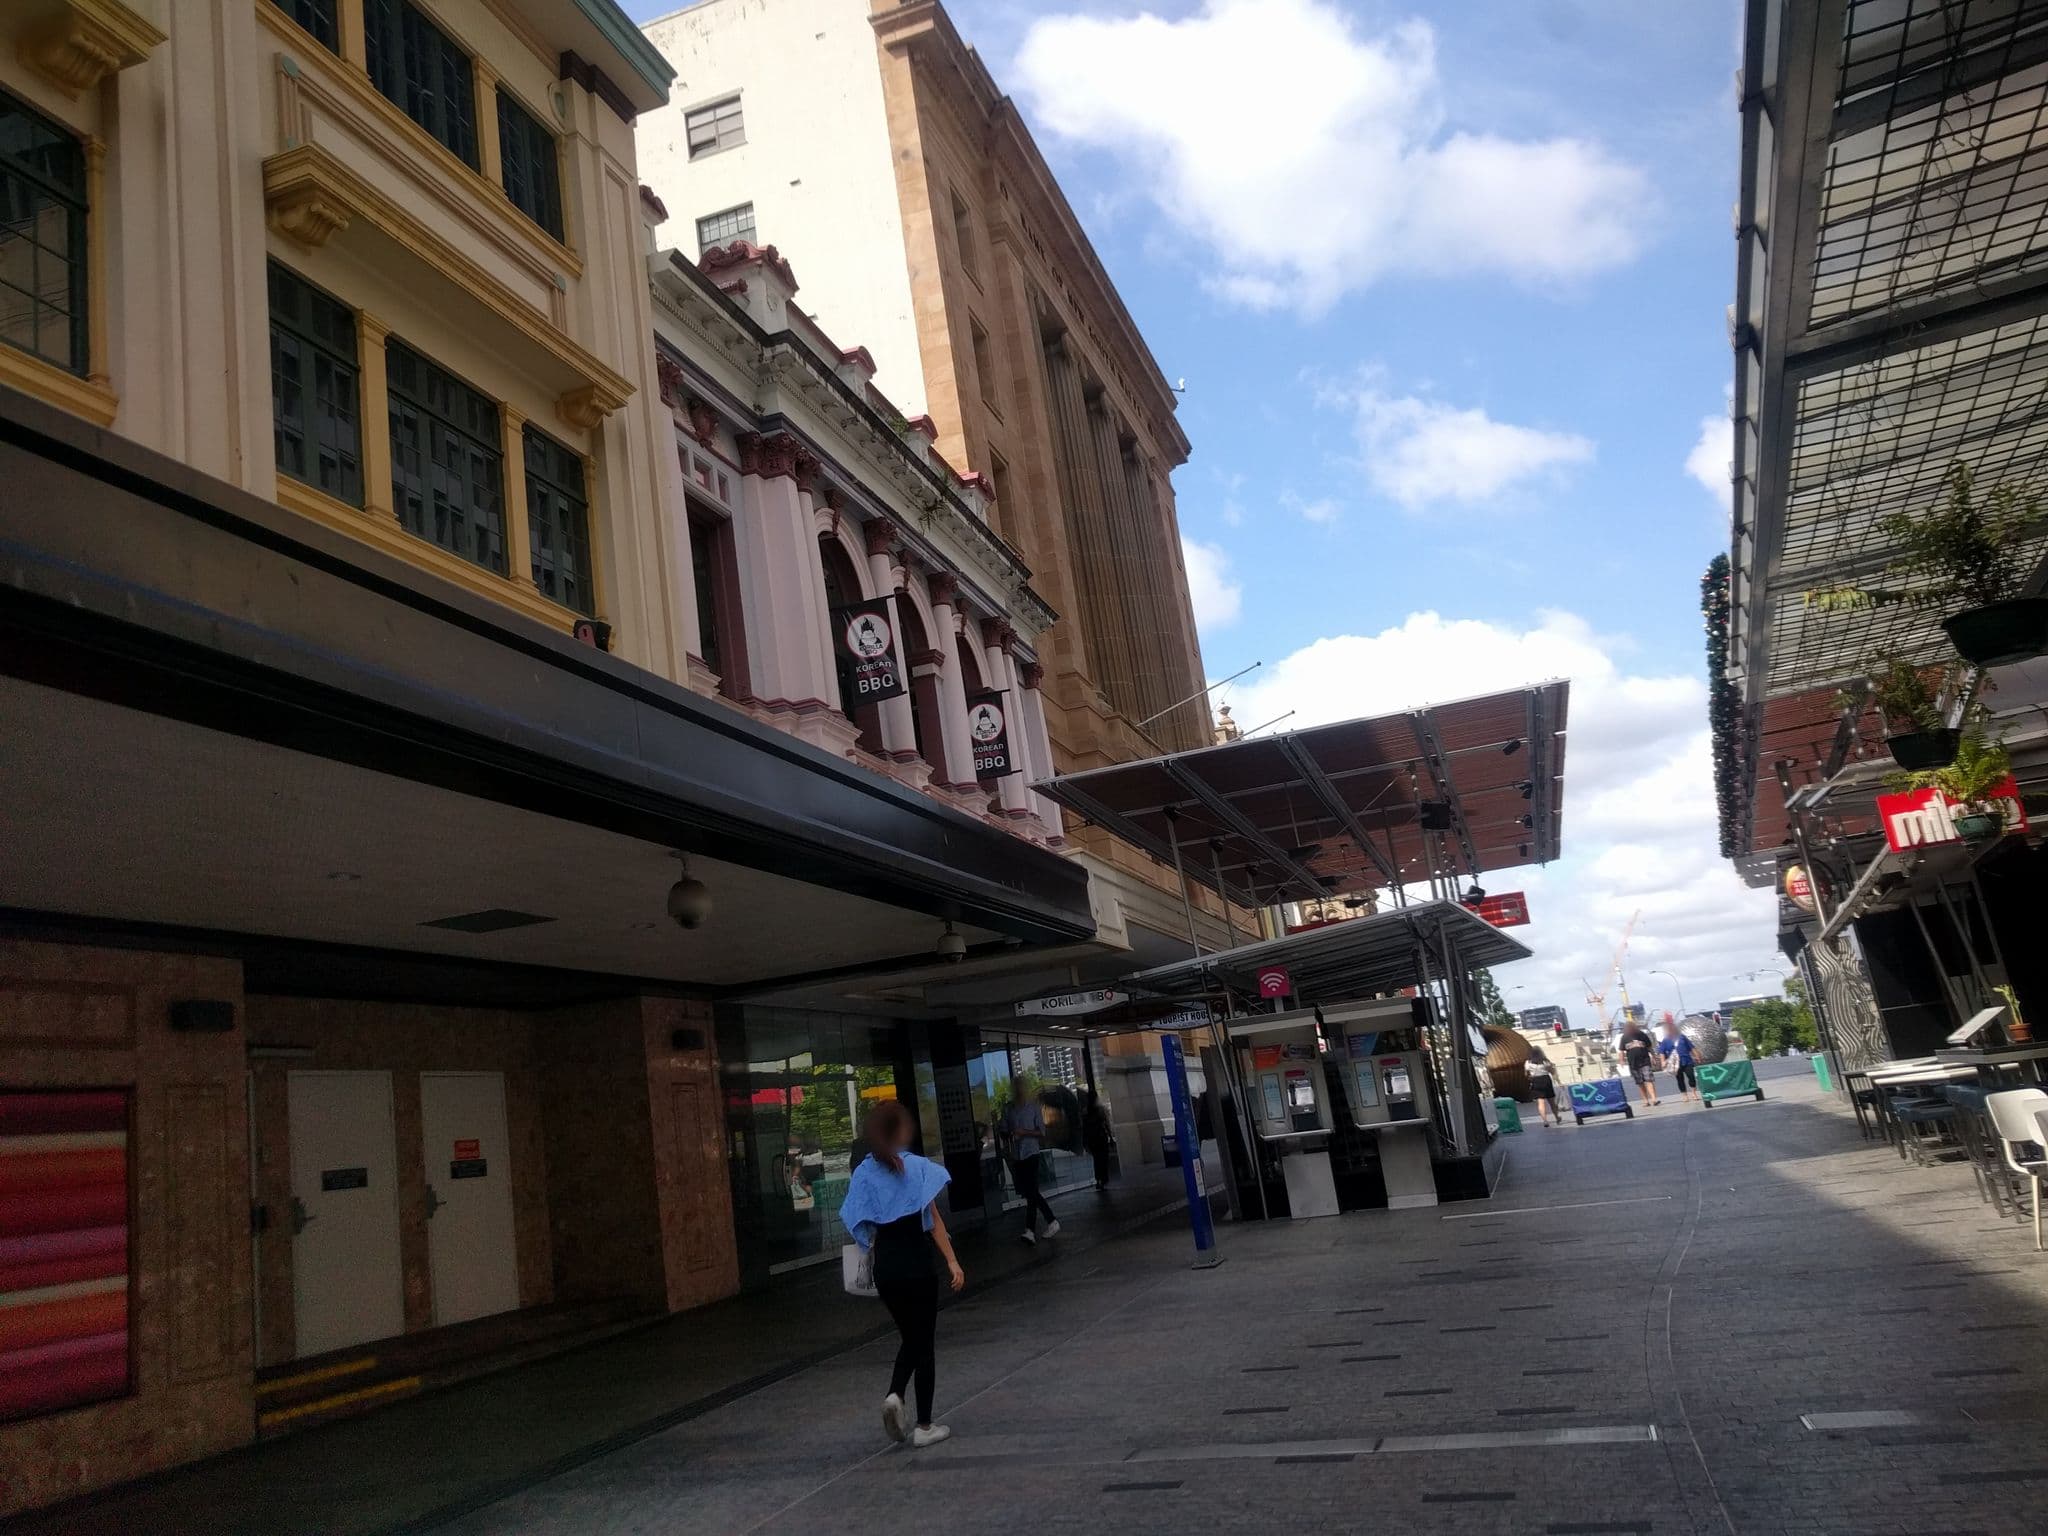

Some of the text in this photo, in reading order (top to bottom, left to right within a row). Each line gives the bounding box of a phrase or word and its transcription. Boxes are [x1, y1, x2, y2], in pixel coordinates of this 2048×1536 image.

[858, 673, 896, 694] BBQ
[975, 755, 1006, 771] BBQ
[1040, 993, 1088, 1010] KORIL
[1158, 1012, 1189, 1025] TOURIST
